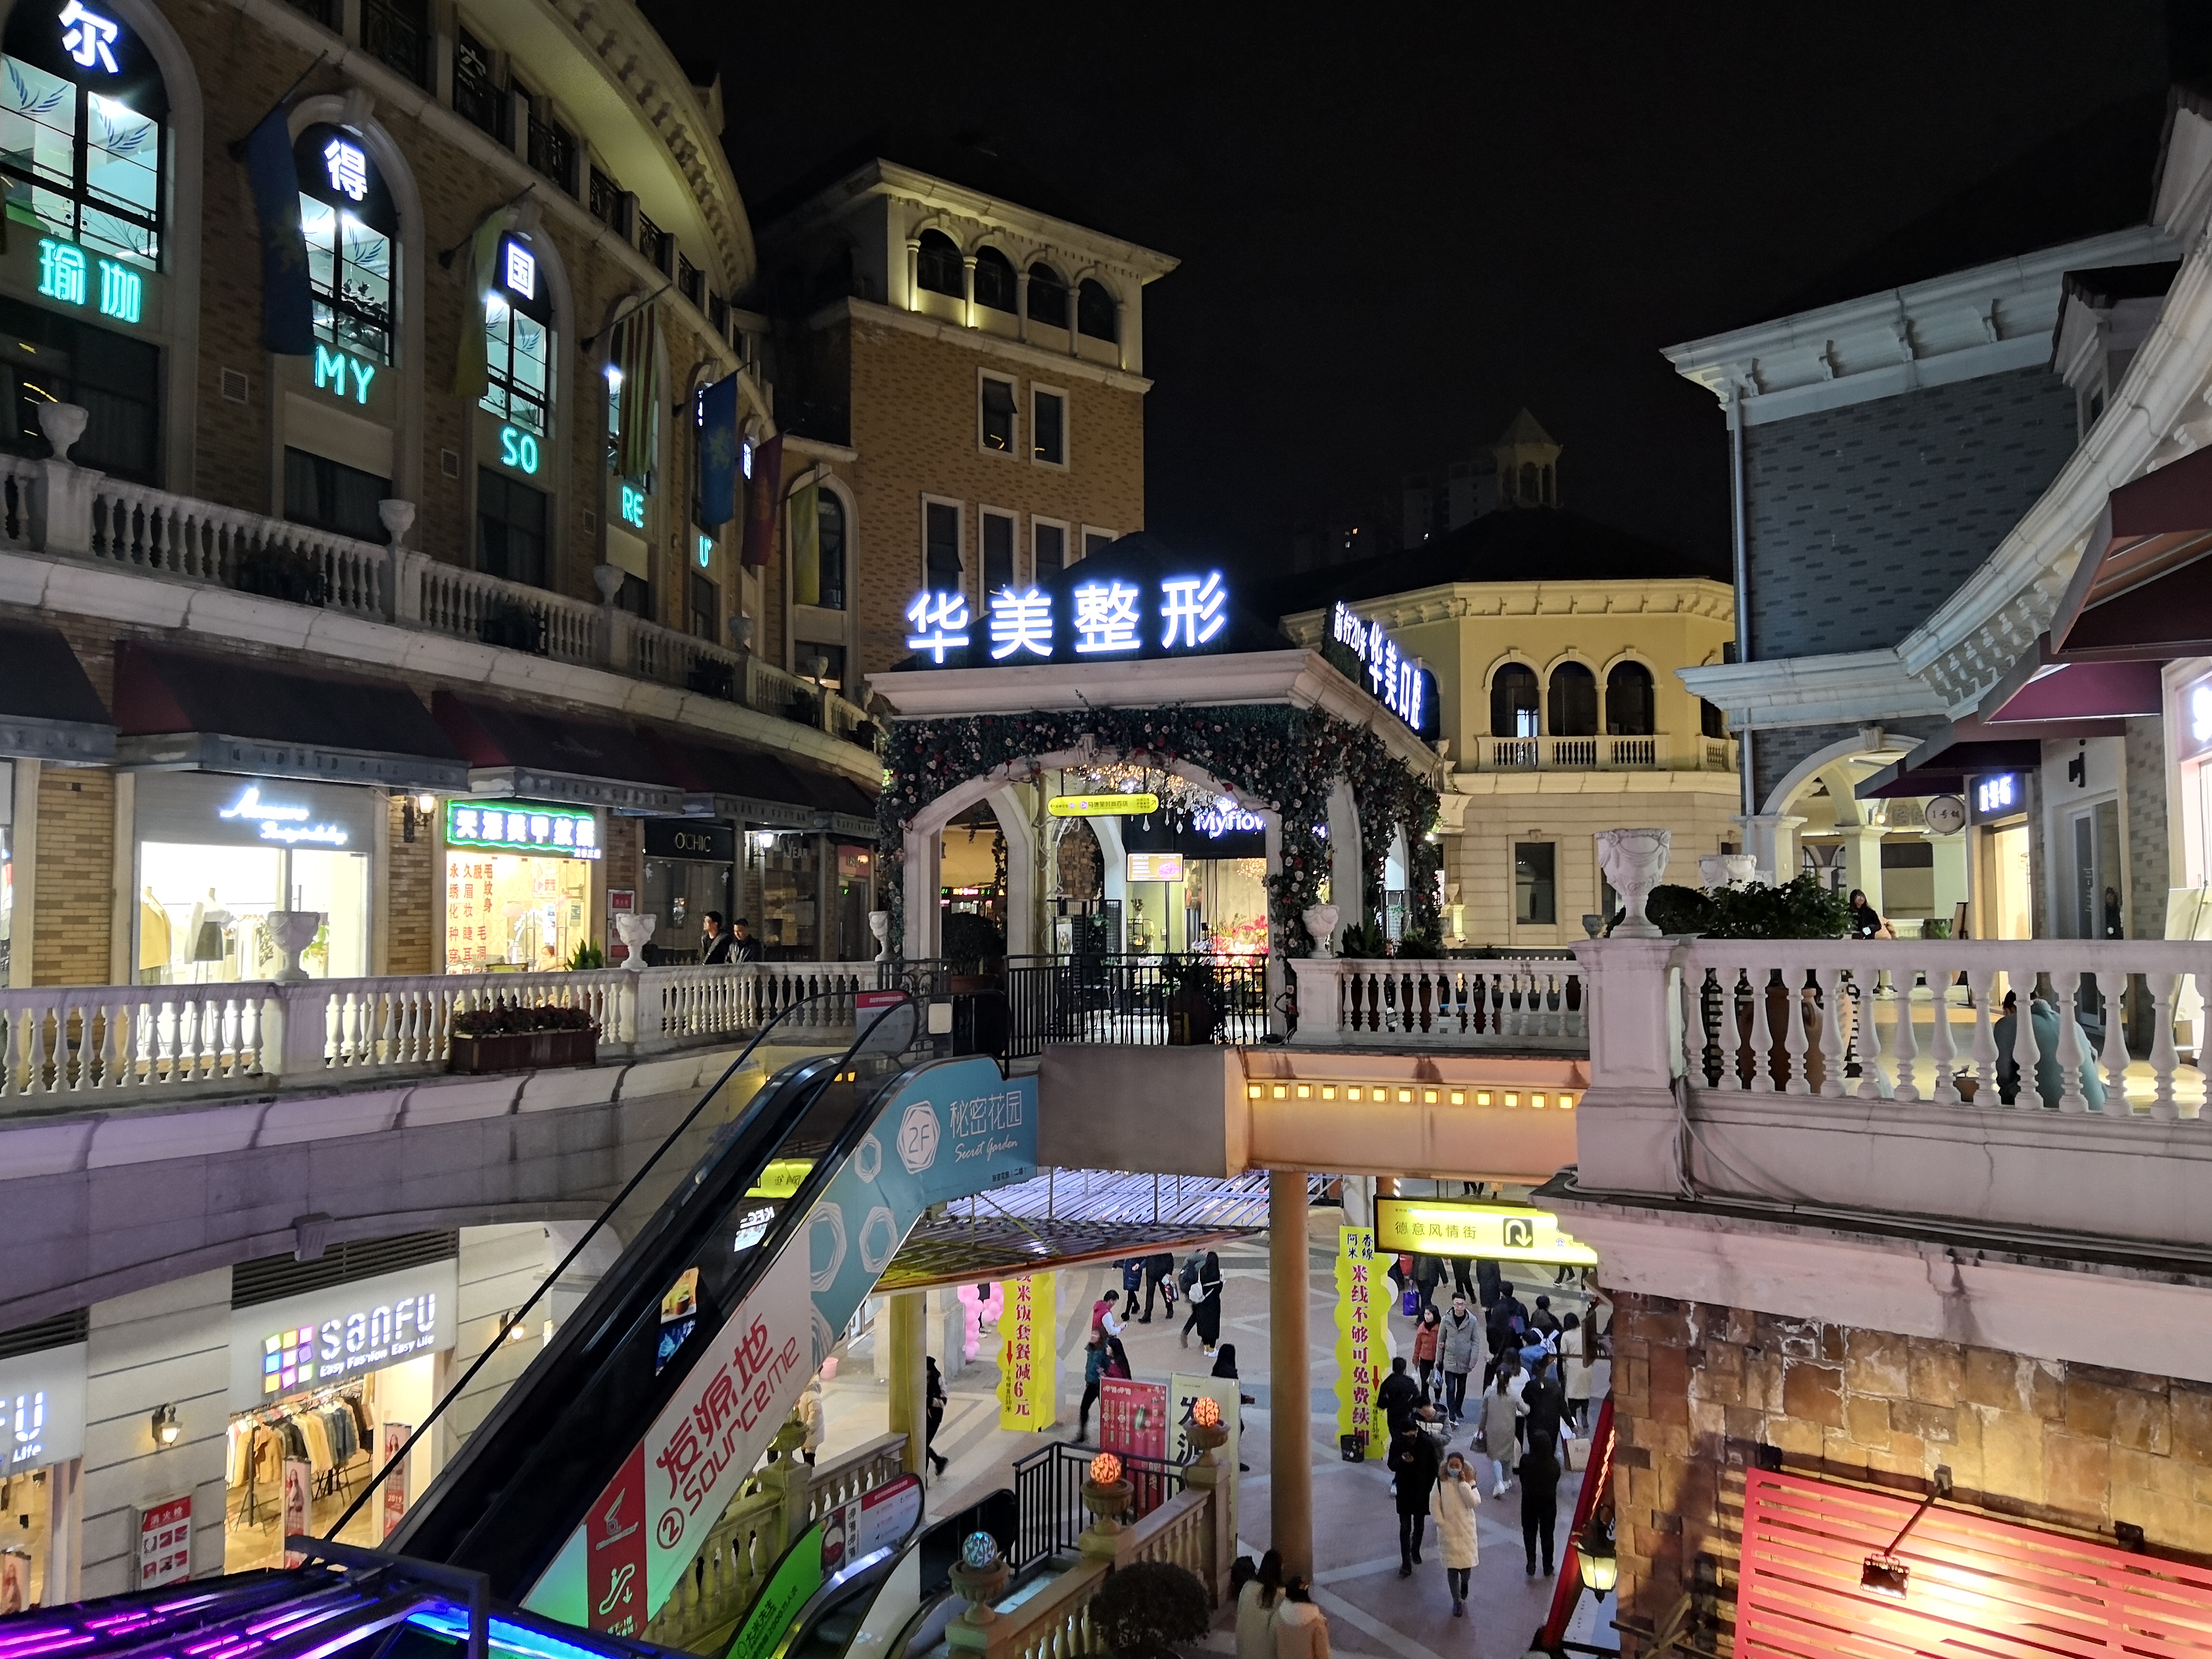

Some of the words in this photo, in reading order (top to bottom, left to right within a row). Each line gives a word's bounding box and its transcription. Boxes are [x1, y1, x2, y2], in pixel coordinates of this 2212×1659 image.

[58, 0, 118, 73] 尔
[324, 139, 369, 202] 得
[38, 239, 141, 323] 瑜伽
[506, 241, 535, 301] 国
[314, 345, 375, 404] MY
[501, 426, 538, 474] SO
[622, 484, 644, 528] RE
[907, 572, 1227, 664] 华美整形
[449, 863, 493, 879] 永久脱毛
[449, 884, 473, 899] 绣眉
[483, 881, 493, 913] 纹身
[449, 903, 473, 919] 化妆
[449, 926, 486, 941] 种睫毛
[449, 946, 486, 963] 穿耳洞
[950, 1091, 1022, 1139] 秘密花园
[909, 1124, 929, 1154] 2F
[955, 1142, 983, 1162] Secret
[1395, 1221, 1477, 1239] 德意风情街
[319, 1362, 345, 1378] Easy
[391, 1340, 415, 1357] Easy
[416, 1335, 434, 1348] Life
[12, 1444, 42, 1463] Life
[388, 1494, 402, 1503] 2019
